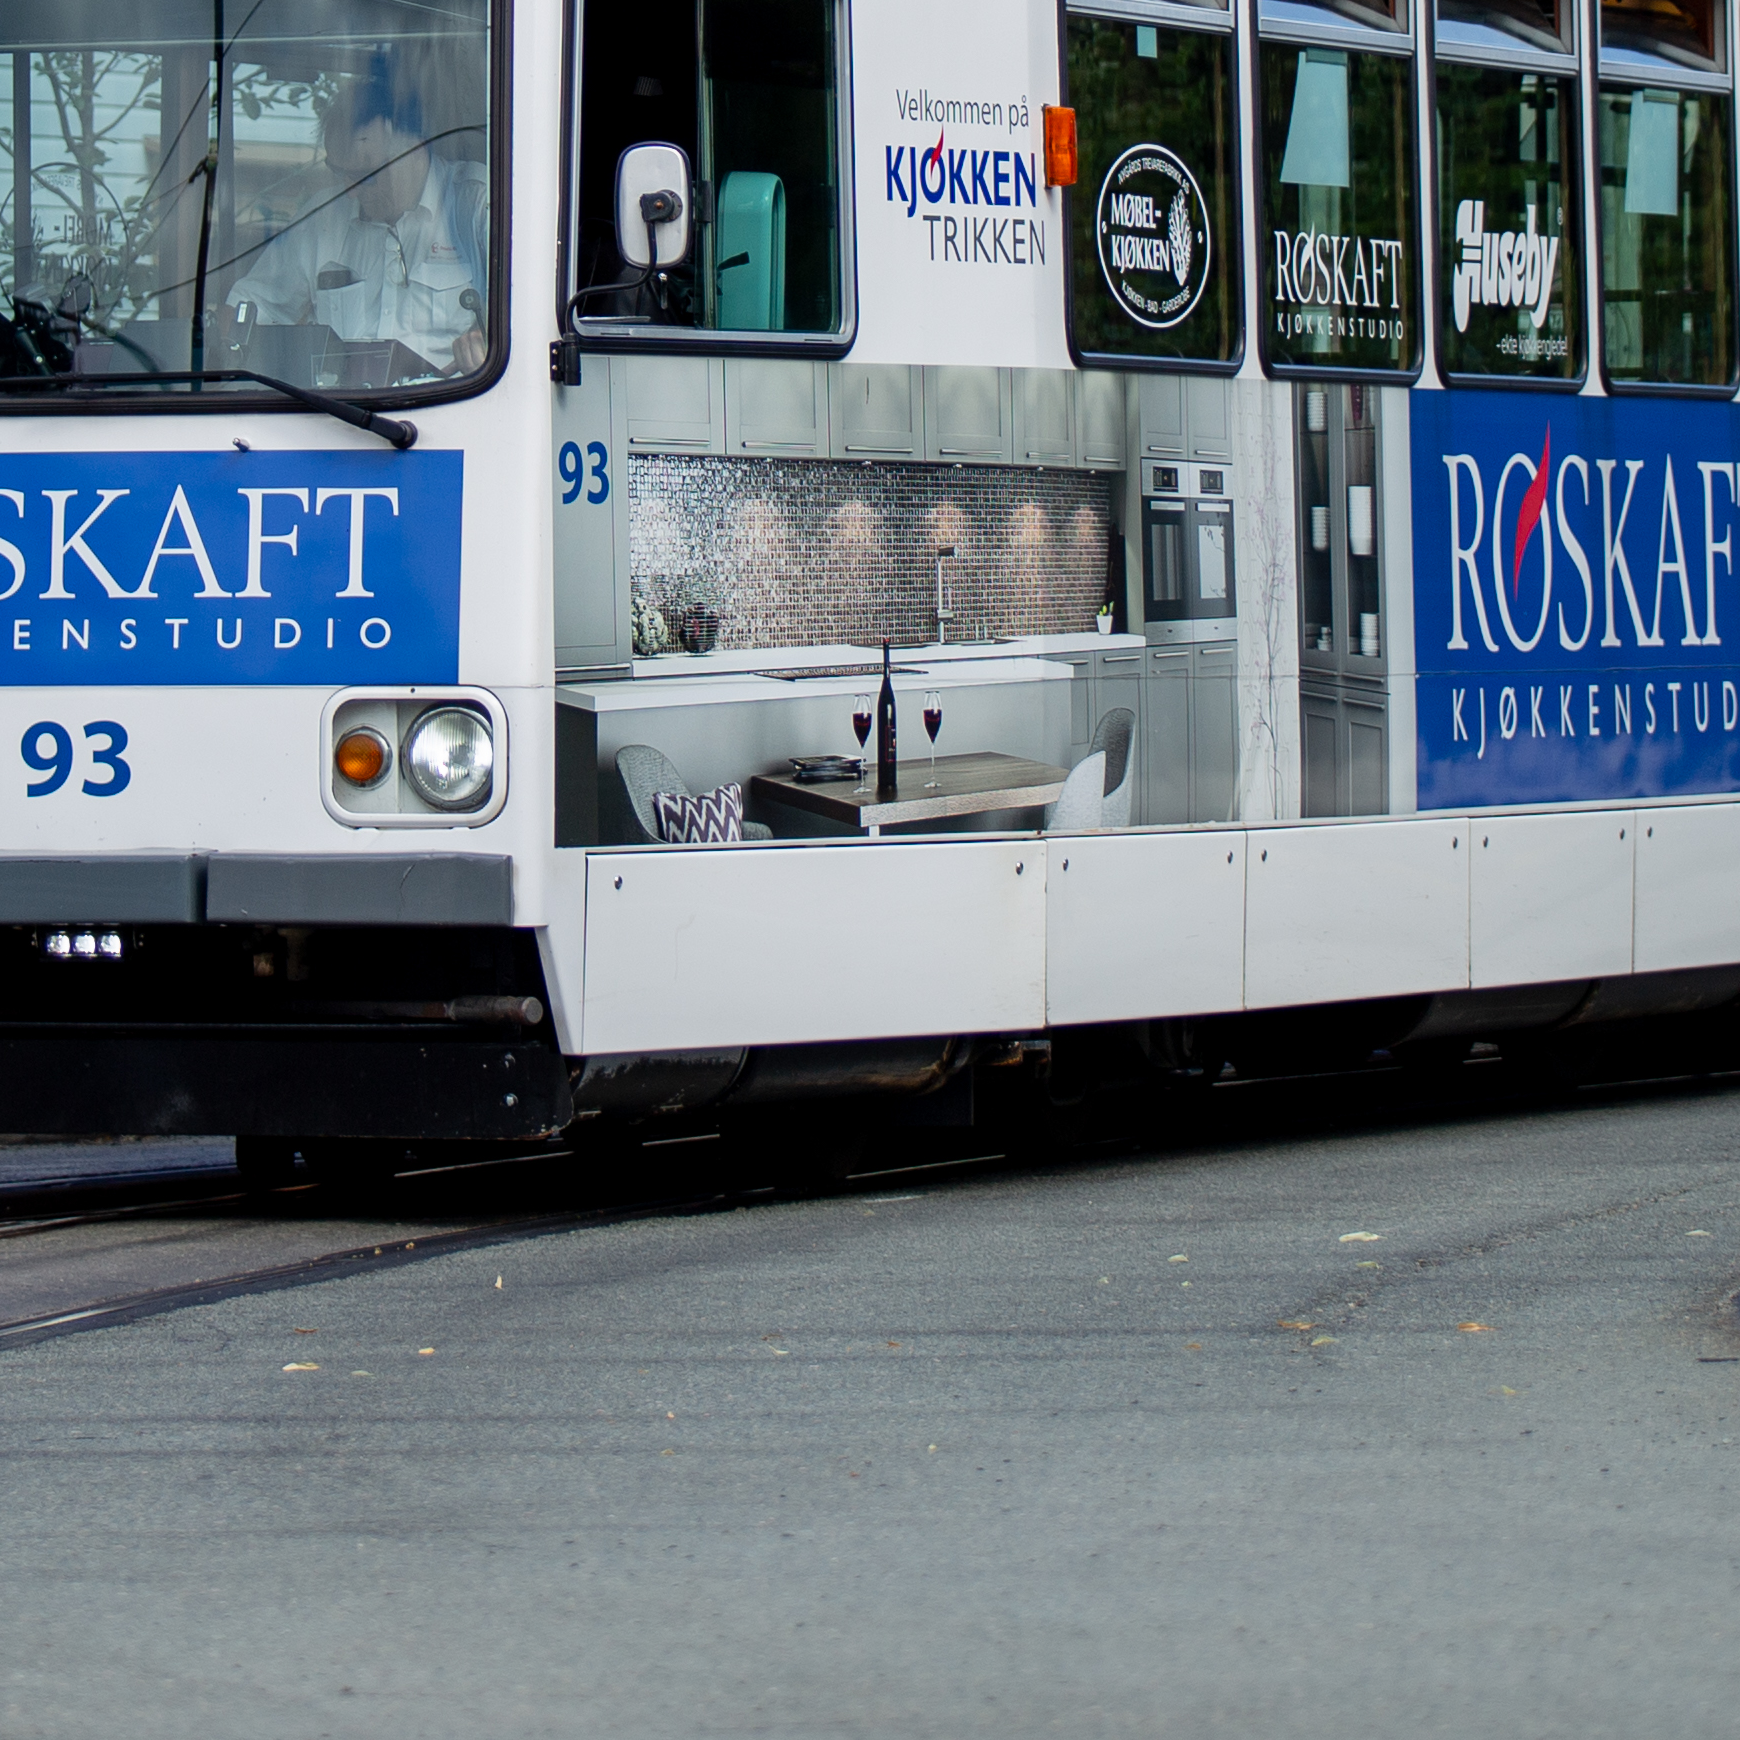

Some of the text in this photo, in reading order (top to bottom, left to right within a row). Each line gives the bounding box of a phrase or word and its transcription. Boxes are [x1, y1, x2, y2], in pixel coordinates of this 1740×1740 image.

[896, 88, 1030, 134] Velkommen på
[885, 124, 1037, 218] KJØKKEN
[1110, 192, 1162, 229] MØBEL-
[922, 214, 1046, 266] TRIKKEN
[1110, 234, 1171, 273] KJØKKEN
[1273, 220, 1403, 309] RØSKAFT
[1453, 199, 1560, 333] Huseby
[1277, 312, 1404, 340] KJØKKENSTUDIO
[557, 440, 610, 505] 93
[19, 718, 133, 798] 93
